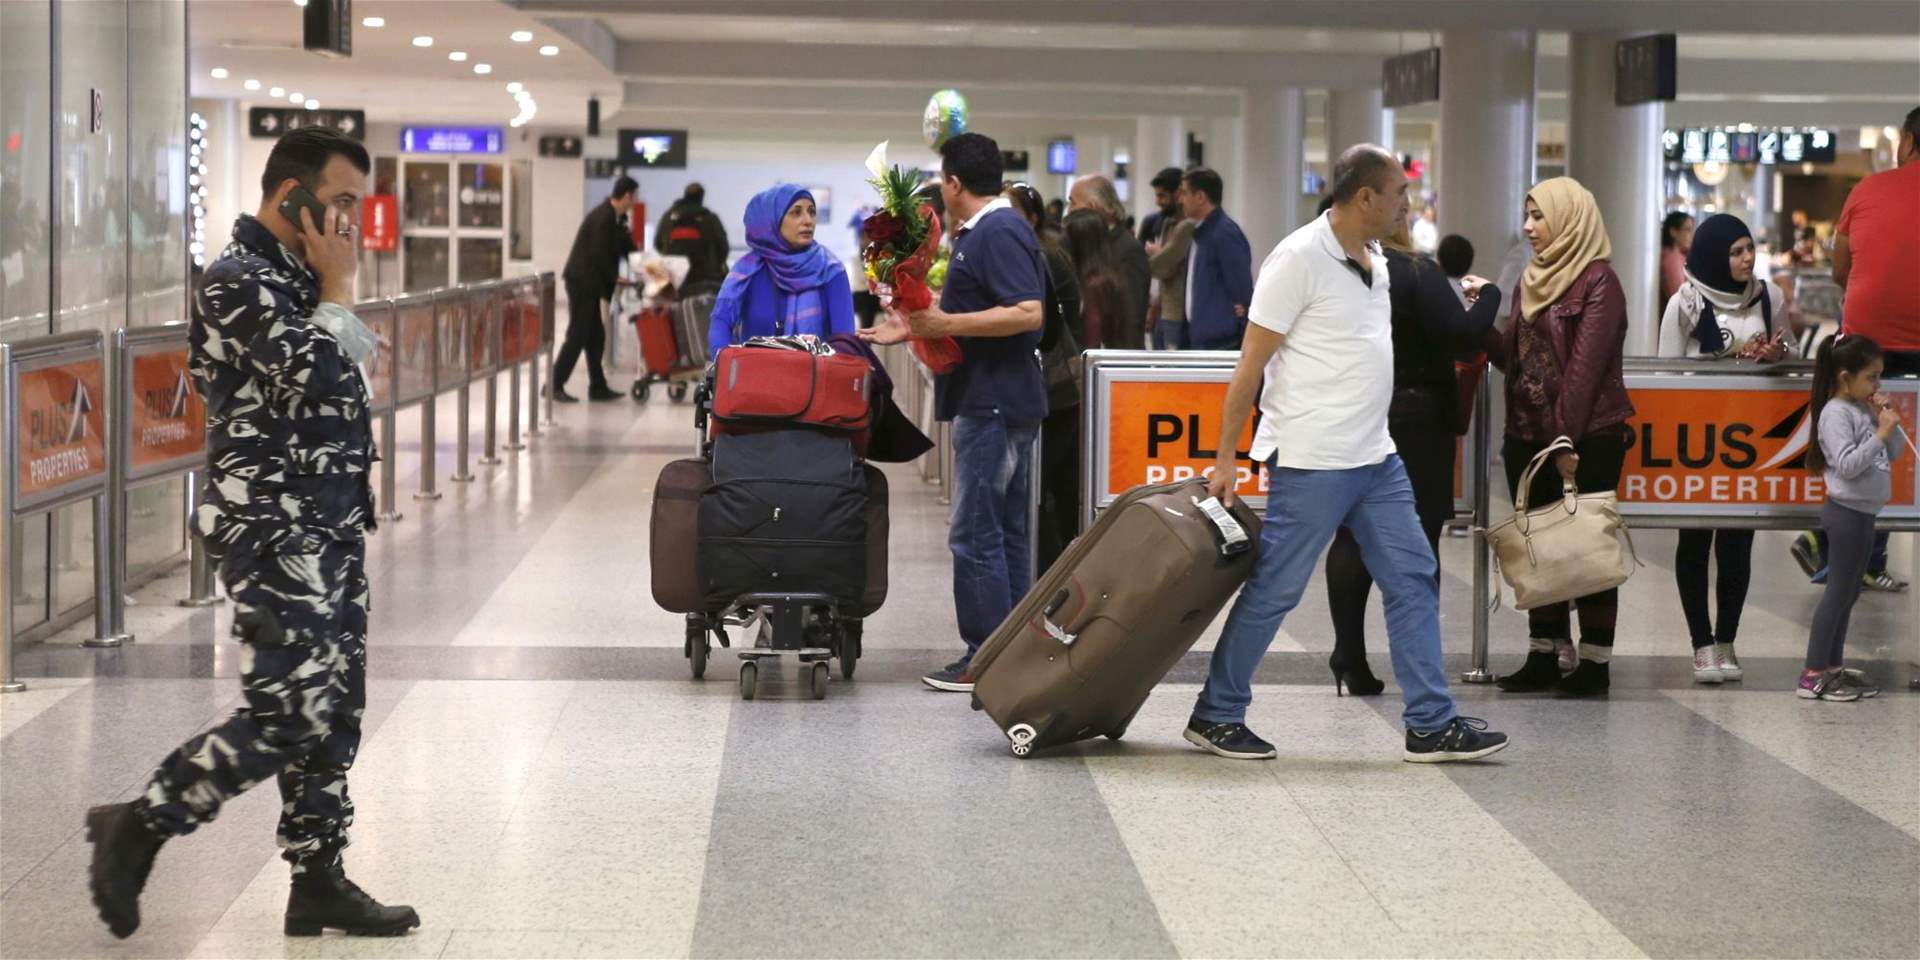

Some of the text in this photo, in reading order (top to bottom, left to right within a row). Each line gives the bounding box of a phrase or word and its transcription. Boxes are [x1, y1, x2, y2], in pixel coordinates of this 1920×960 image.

[145, 389, 174, 420] PLUS
[31, 402, 70, 451] PLUS
[142, 423, 186, 446] PROPERTIES
[30, 448, 88, 485] PROPERTIES
[1626, 474, 1823, 500] ROPERTIE
